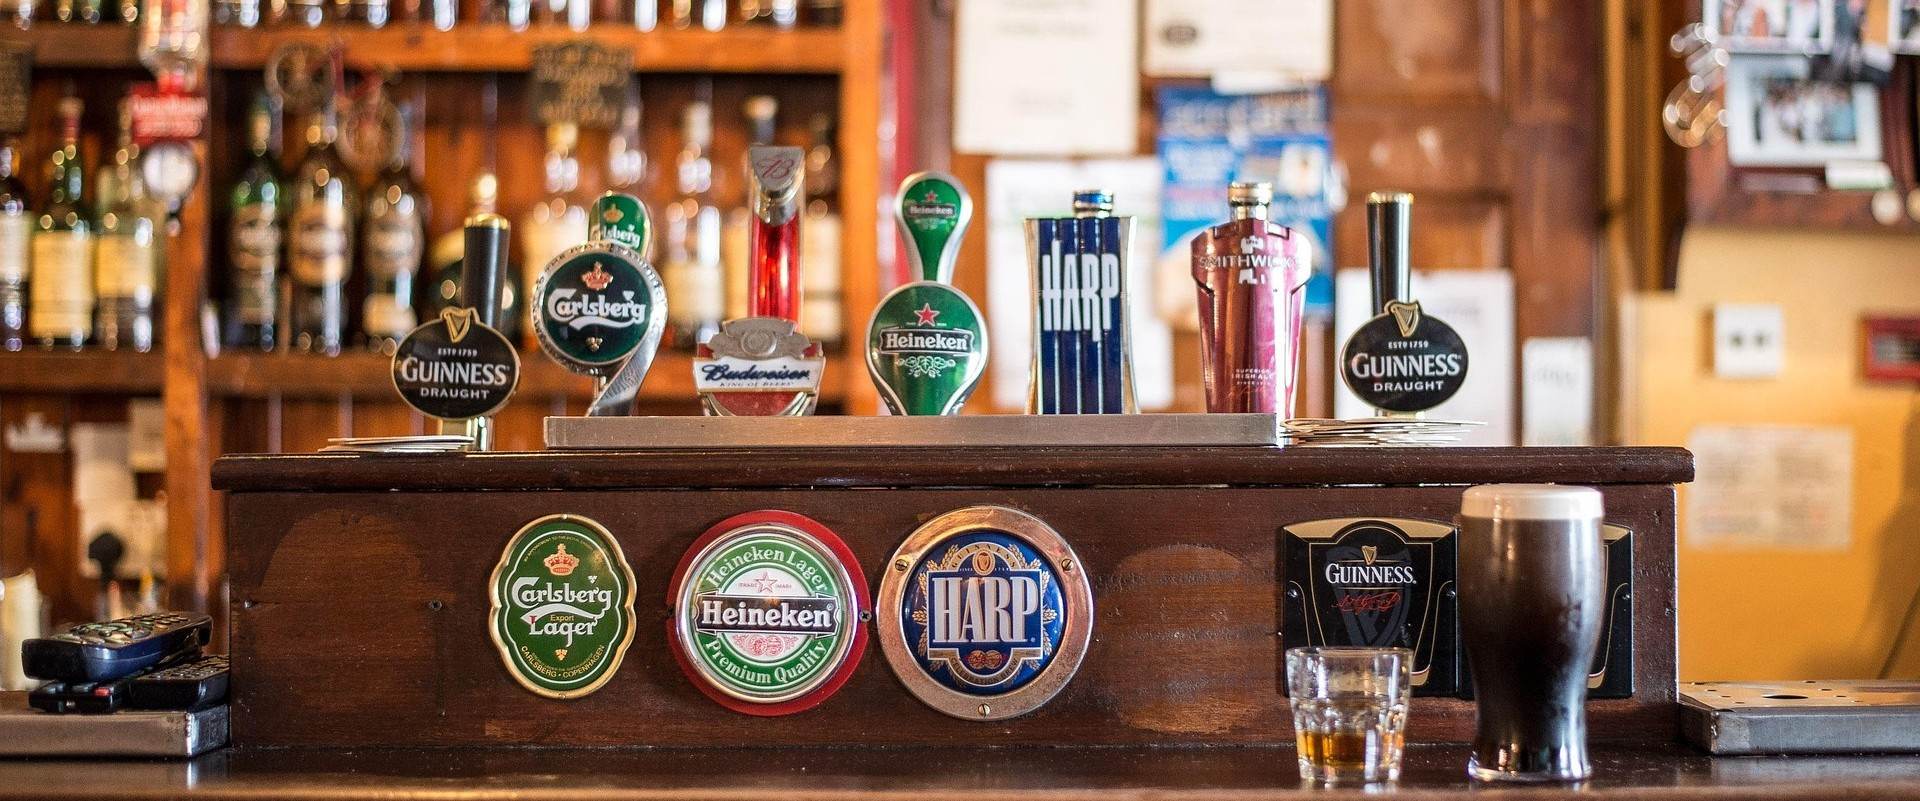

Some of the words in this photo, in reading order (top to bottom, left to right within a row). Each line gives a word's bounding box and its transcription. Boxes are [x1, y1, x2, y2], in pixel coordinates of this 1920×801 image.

[1042, 239, 1120, 342] HARP
[547, 288, 647, 327] Carlsberg
[886, 332, 968, 351] Heineken
[1409, 340, 1429, 350] 1759
[401, 356, 508, 386] GUINNESS
[702, 364, 810, 381] Budweiser
[1351, 353, 1460, 379] GUINNESS
[420, 387, 490, 399] DRAUGHT
[1374, 381, 1445, 392] DRAUGHT
[706, 546, 784, 588] Heineken
[786, 550, 828, 592] Lager
[1325, 563, 1414, 584] GUINNESS
[511, 576, 614, 612] Carlsberg
[550, 614, 576, 623] Export
[701, 599, 832, 628] Heineken
[932, 576, 1039, 643] HARP
[529, 615, 598, 648] Lager
[521, 644, 558, 679] CARLSBERG
[561, 643, 606, 679] COPENHAGEN
[705, 641, 772, 684] Premium
[774, 642, 828, 684] Quality
